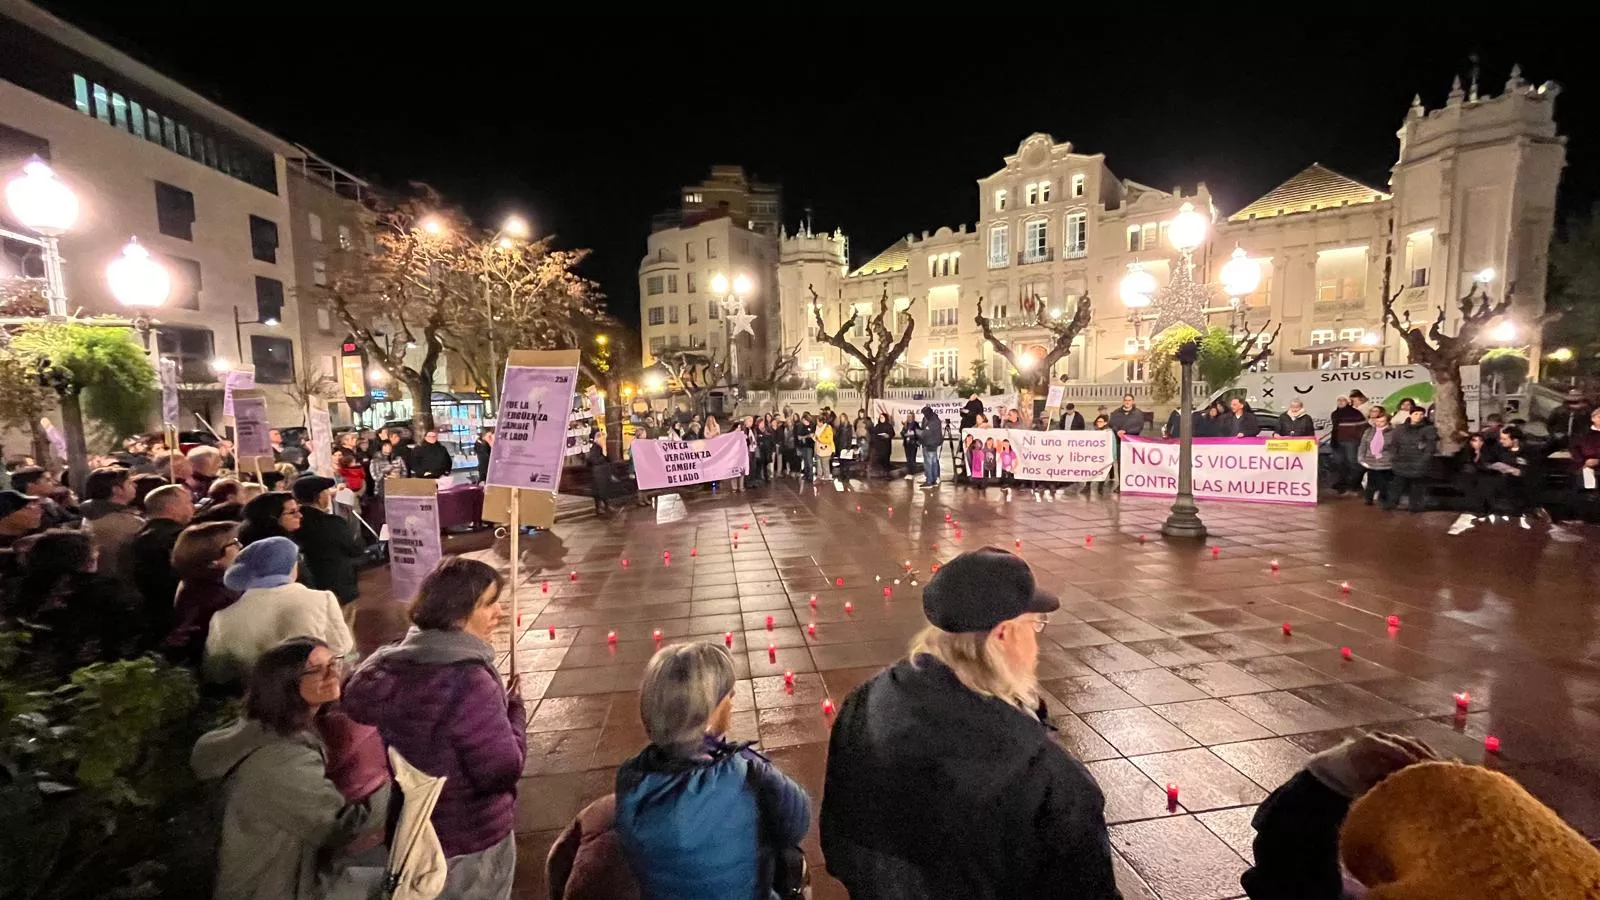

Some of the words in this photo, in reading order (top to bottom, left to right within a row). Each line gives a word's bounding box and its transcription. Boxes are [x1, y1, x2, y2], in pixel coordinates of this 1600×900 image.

[1321, 369, 1415, 382] SATUSONIC
[520, 401, 529, 410] LA
[505, 411, 548, 421] ERGÜENZA
[662, 442, 678, 451] QUE
[679, 442, 689, 450] LA
[1022, 436, 1036, 447] Ni
[1041, 438, 1062, 447] una
[1067, 437, 1106, 447] menos
[1022, 452, 1051, 462] vivas
[1056, 453, 1064, 464] y
[1069, 451, 1105, 463] libres
[1132, 446, 1163, 466] NO
[1168, 454, 1203, 469] MS
[1207, 454, 1304, 471] VIOLENCIA
[665, 462, 697, 473] CAMBIE
[1022, 465, 1041, 475] nos
[1046, 465, 1104, 478] queremos
[667, 475, 678, 484] DE
[678, 472, 700, 483] LADO
[1125, 474, 1177, 489] CONTR
[1193, 479, 1223, 493] LAS
[1228, 480, 1311, 497] MUJERES
